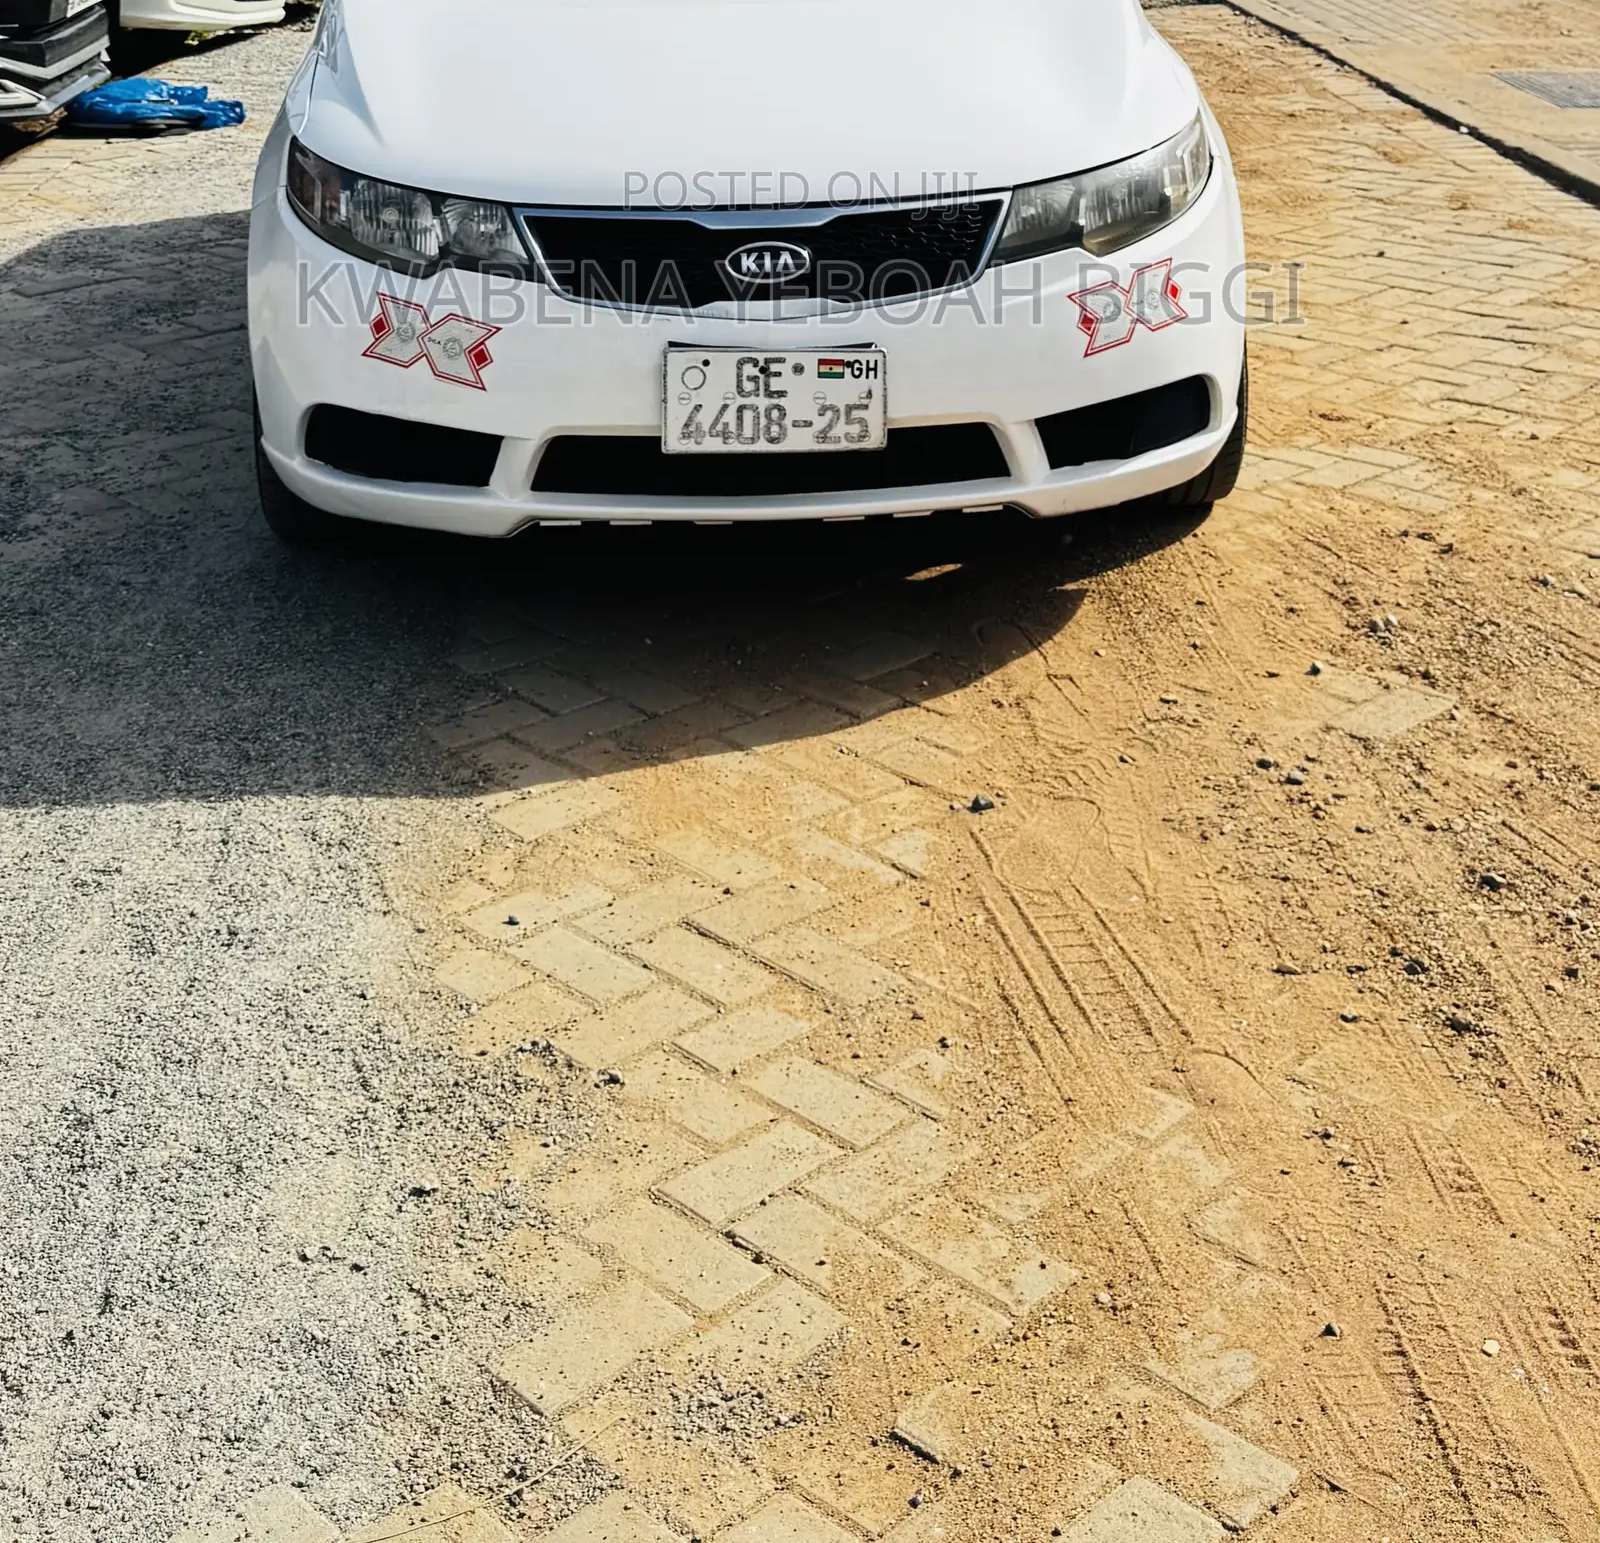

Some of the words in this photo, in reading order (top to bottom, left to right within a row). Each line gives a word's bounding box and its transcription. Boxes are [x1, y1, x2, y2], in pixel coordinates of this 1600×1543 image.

[740, 251, 796, 273] KIA
[736, 357, 788, 399] GE
[850, 359, 878, 379] GH
[682, 403, 870, 446] 4408-25
